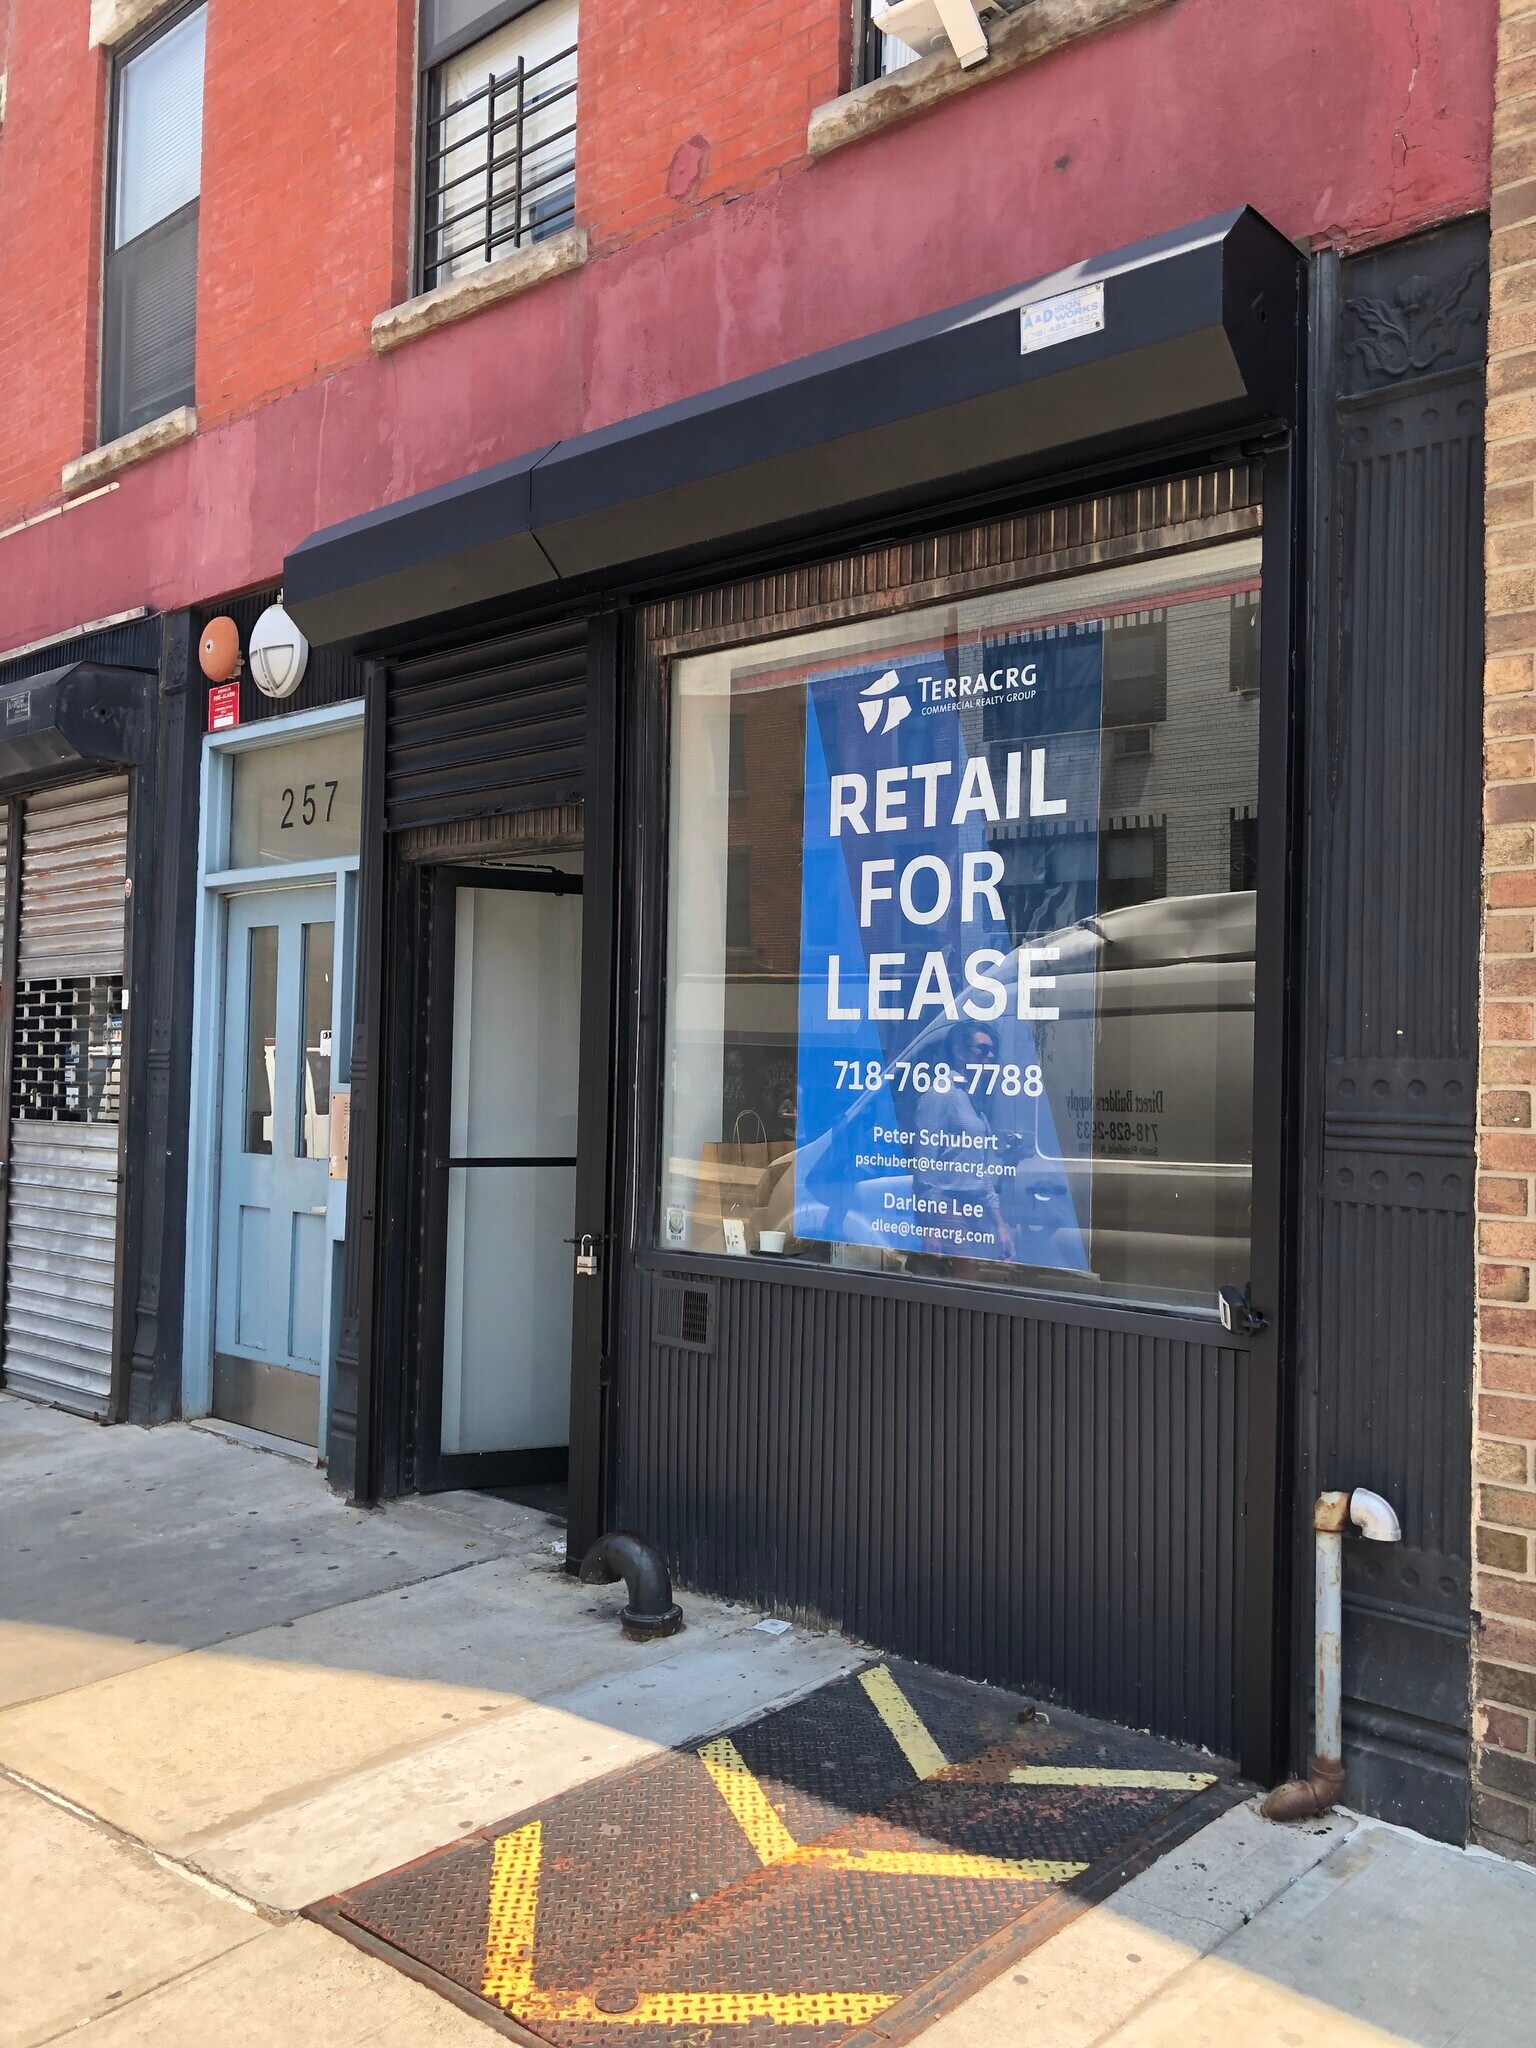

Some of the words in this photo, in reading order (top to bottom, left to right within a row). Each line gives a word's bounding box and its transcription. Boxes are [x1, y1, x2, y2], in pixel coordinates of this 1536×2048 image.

[1054, 301, 1081, 314] IRON
[1055, 301, 1099, 322] WORKS
[921, 700, 974, 717] COMMERCIAL
[975, 695, 1005, 708] REALTY
[1006, 690, 1037, 703] GROUP
[280, 780, 338, 829] 257
[829, 748, 1067, 837] RETAIL
[860, 850, 1006, 928] FOR
[826, 947, 1060, 1022] LEASE
[833, 1060, 1043, 1098] 718-768-7788
[873, 1126, 915, 1146] Peter
[919, 1128, 998, 1151] Schubert
[855, 1152, 1016, 1178] pschubert@terracrg.com
[883, 1192, 948, 1215] Darlene
[952, 1198, 984, 1218] Lee
[871, 1218, 995, 1244] dlee@terracrg.com
